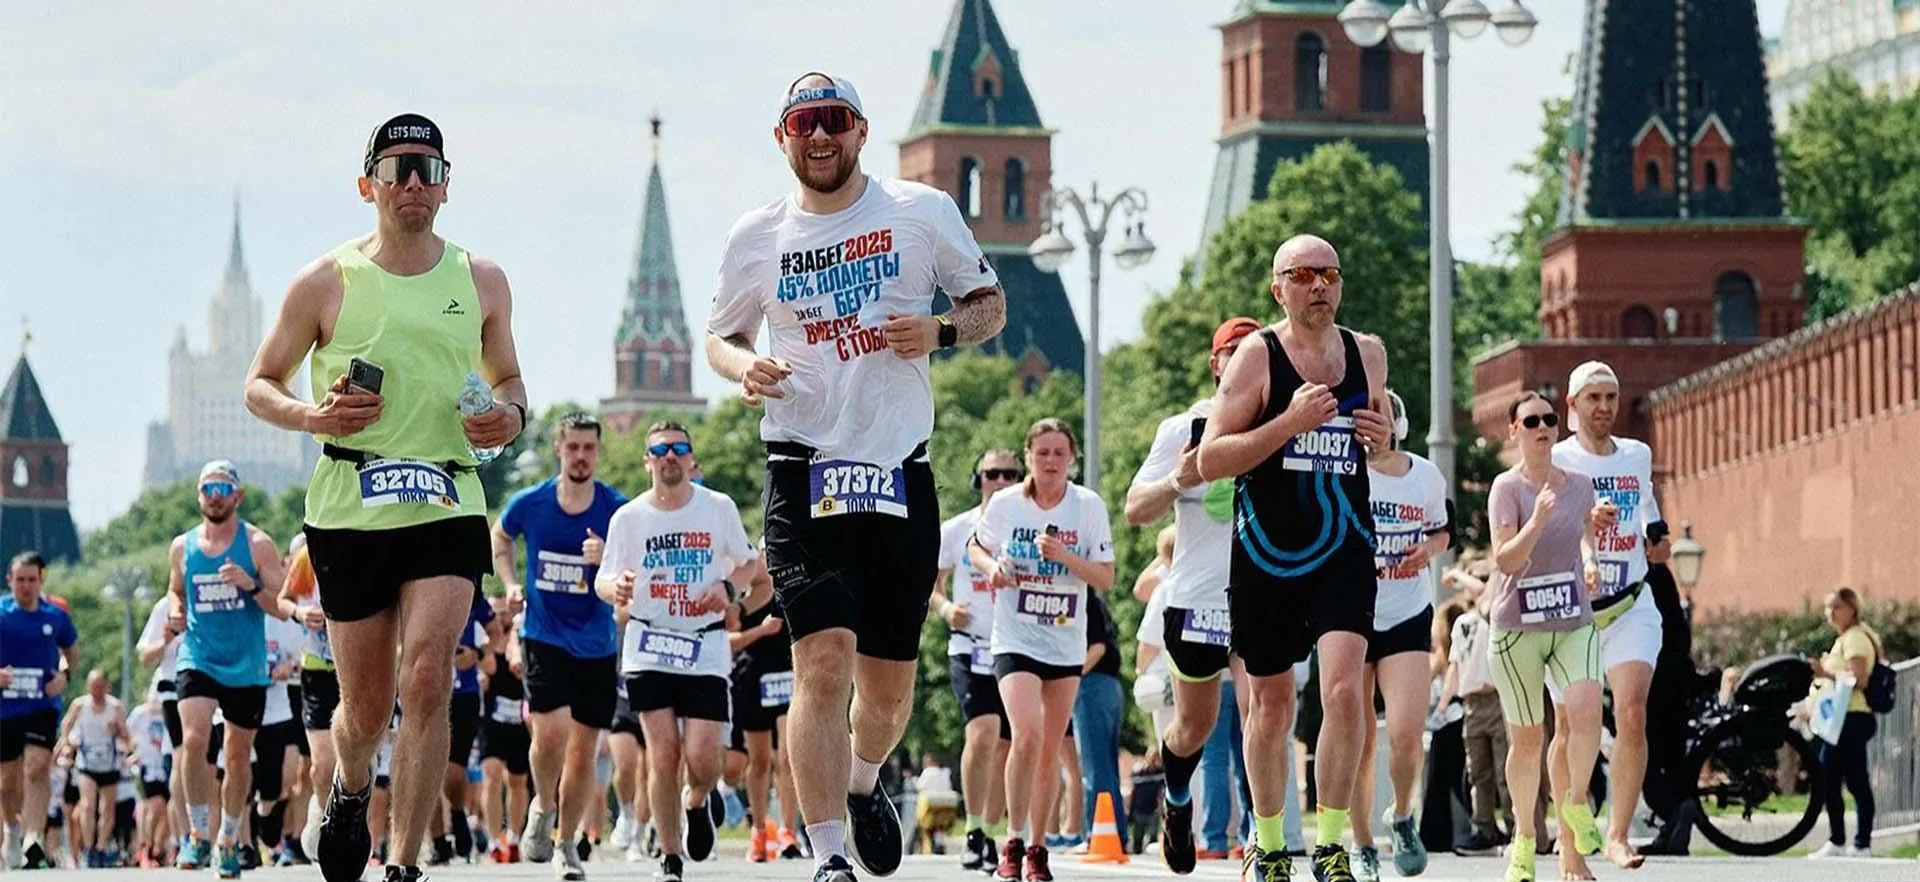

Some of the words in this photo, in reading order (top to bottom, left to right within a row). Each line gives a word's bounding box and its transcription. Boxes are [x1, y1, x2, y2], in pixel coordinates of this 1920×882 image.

[410, 125, 431, 139] MOVE
[780, 229, 893, 277] #ЗАБЕГ2025
[776, 275, 815, 304] 45%
[816, 253, 900, 295] ПЛАНЕТЫ
[833, 281, 883, 318] БЕГУТ
[803, 314, 861, 346] ВМЕСТЕ
[1294, 431, 1351, 458] 30037
[371, 468, 447, 495] 32705
[823, 465, 895, 498] 37372
[397, 492, 429, 504] 10KM
[845, 498, 876, 513] 10KM
[645, 531, 712, 553] #ЗАБЕГ2025
[643, 550, 665, 570] 45%
[666, 548, 714, 567] ПЛАНЕТЫ
[674, 566, 704, 583] БЕГУТ
[650, 583, 689, 600] ВМЕСТЕ
[1525, 584, 1572, 611] 60547
[1024, 593, 1070, 616] 60194
